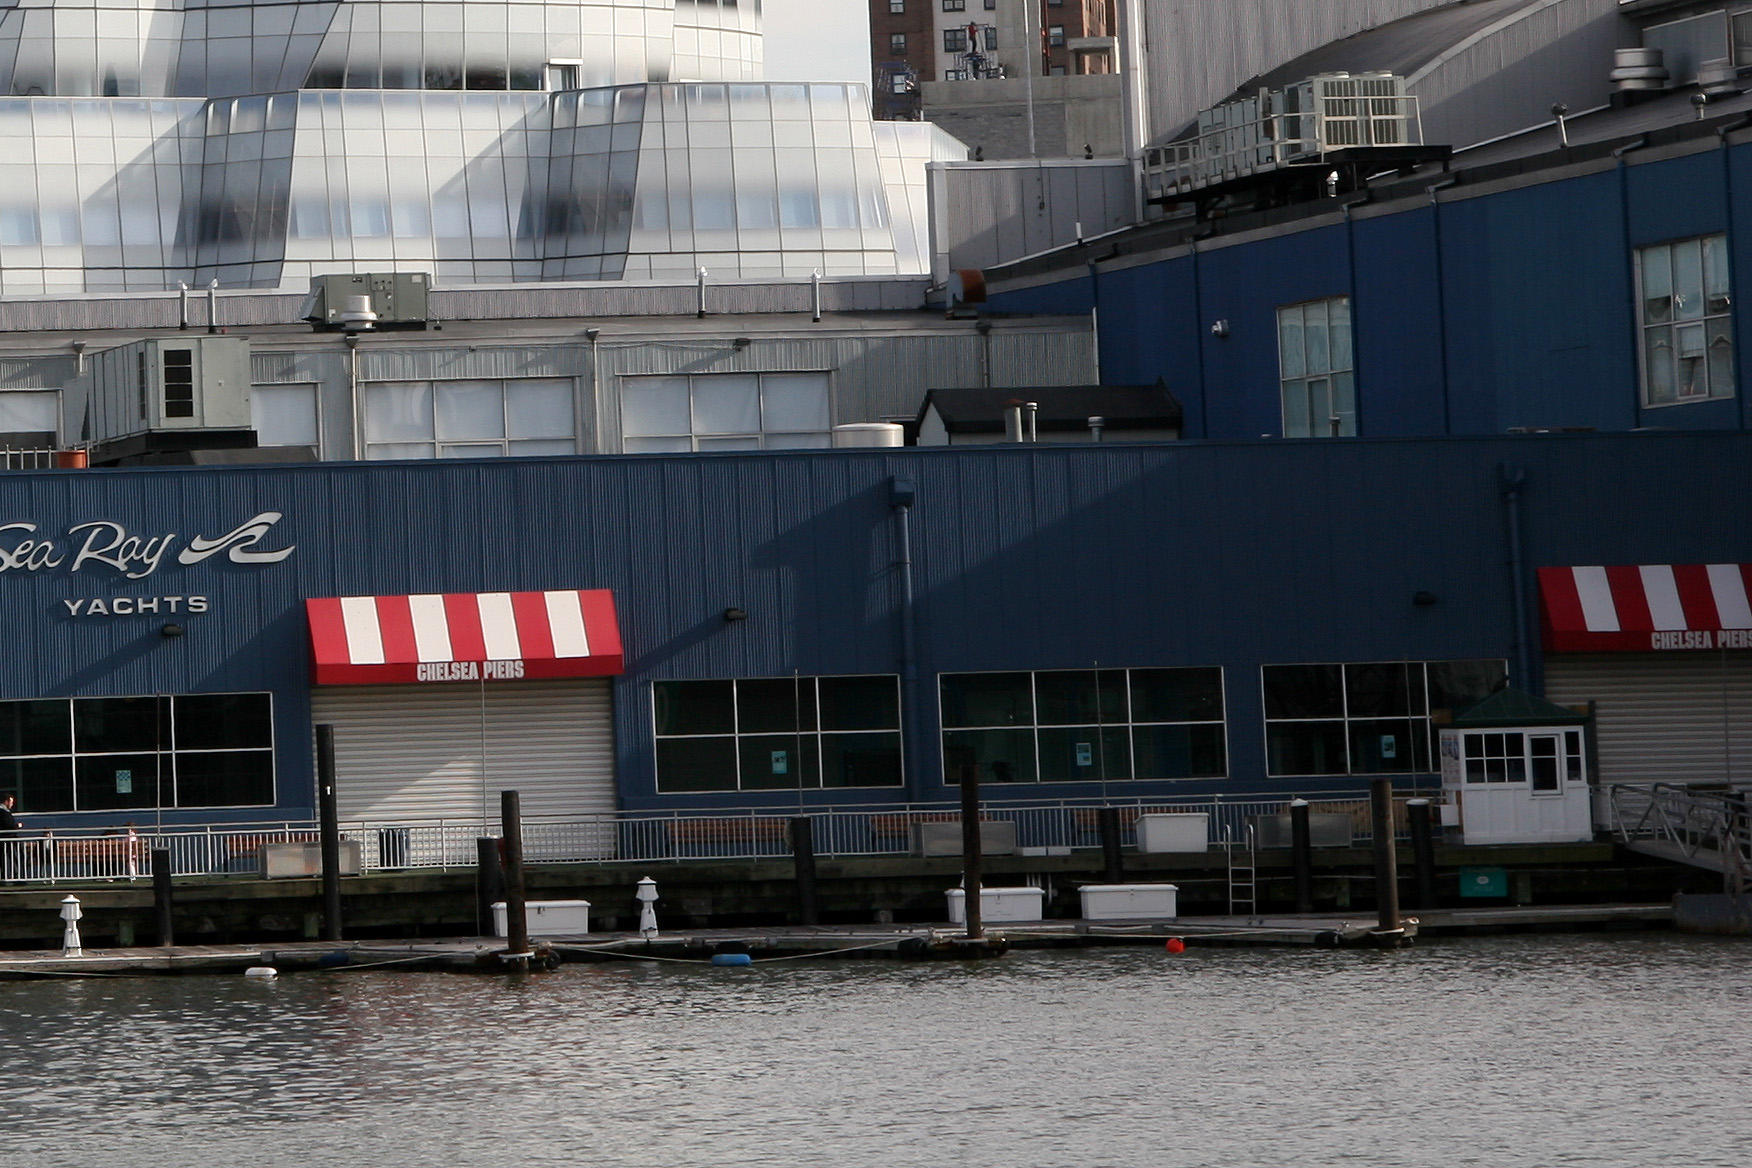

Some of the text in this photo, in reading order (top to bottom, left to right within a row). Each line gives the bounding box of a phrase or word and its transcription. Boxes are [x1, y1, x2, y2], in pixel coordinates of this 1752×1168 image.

[68, 521, 176, 579] Ray
[64, 596, 209, 616] YACHTS
[1651, 631, 1713, 650] CHELSEA
[417, 660, 525, 681] CHELSEA PIERS
